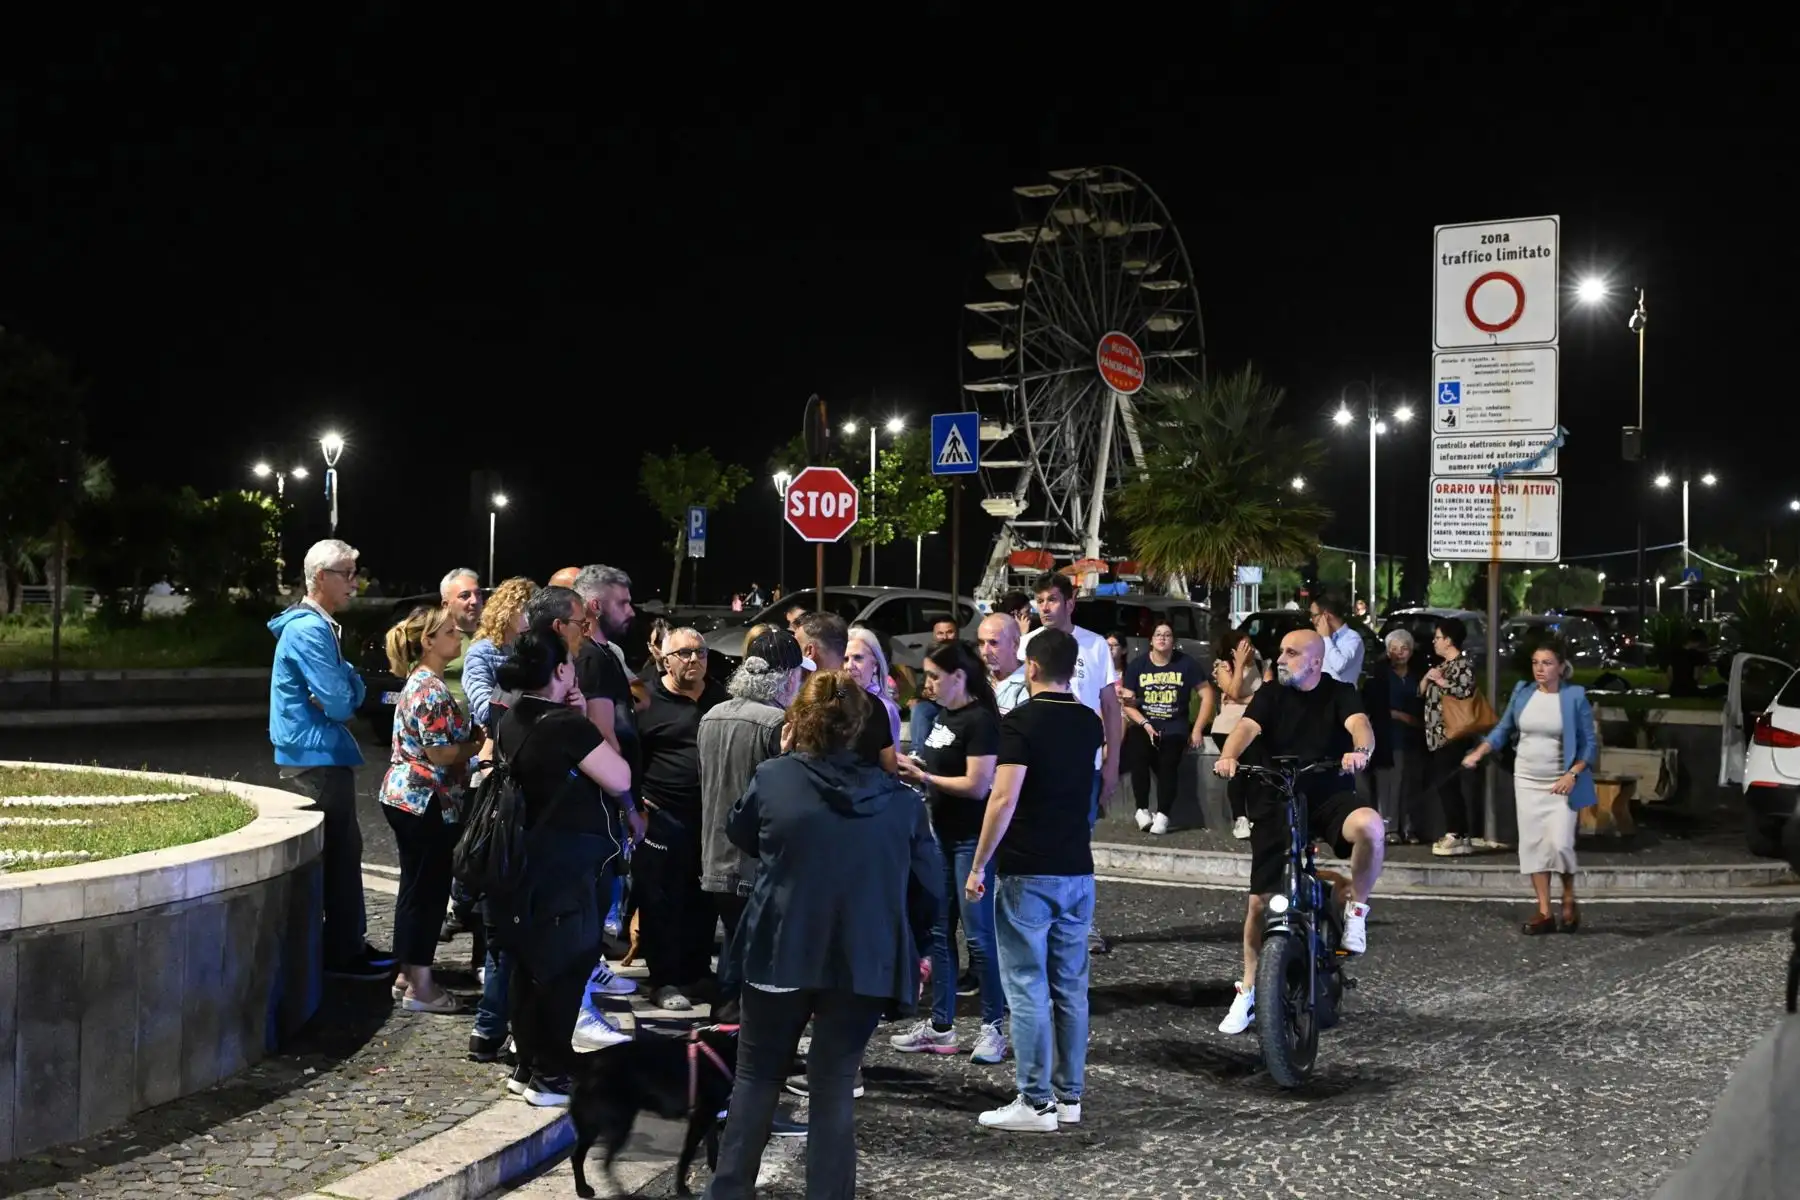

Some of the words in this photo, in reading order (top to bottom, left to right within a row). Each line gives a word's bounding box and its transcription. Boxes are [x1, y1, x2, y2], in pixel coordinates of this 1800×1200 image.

[1481, 233, 1510, 244] zona
[1442, 250, 1492, 265] traffico
[1497, 246, 1550, 261] limitato
[1436, 440, 1468, 450] controllo
[1470, 440, 1506, 448] elettronico
[1508, 439, 1526, 448] degli
[1440, 452, 1484, 460] informazioni
[1486, 451, 1494, 459] ed
[1477, 462, 1496, 470] verde
[1436, 483, 1476, 494] ORARIO
[1479, 484, 1518, 495] VARCHI
[1522, 484, 1556, 496] ATTIVI
[790, 490, 853, 518] STOP
[691, 509, 703, 538] P
